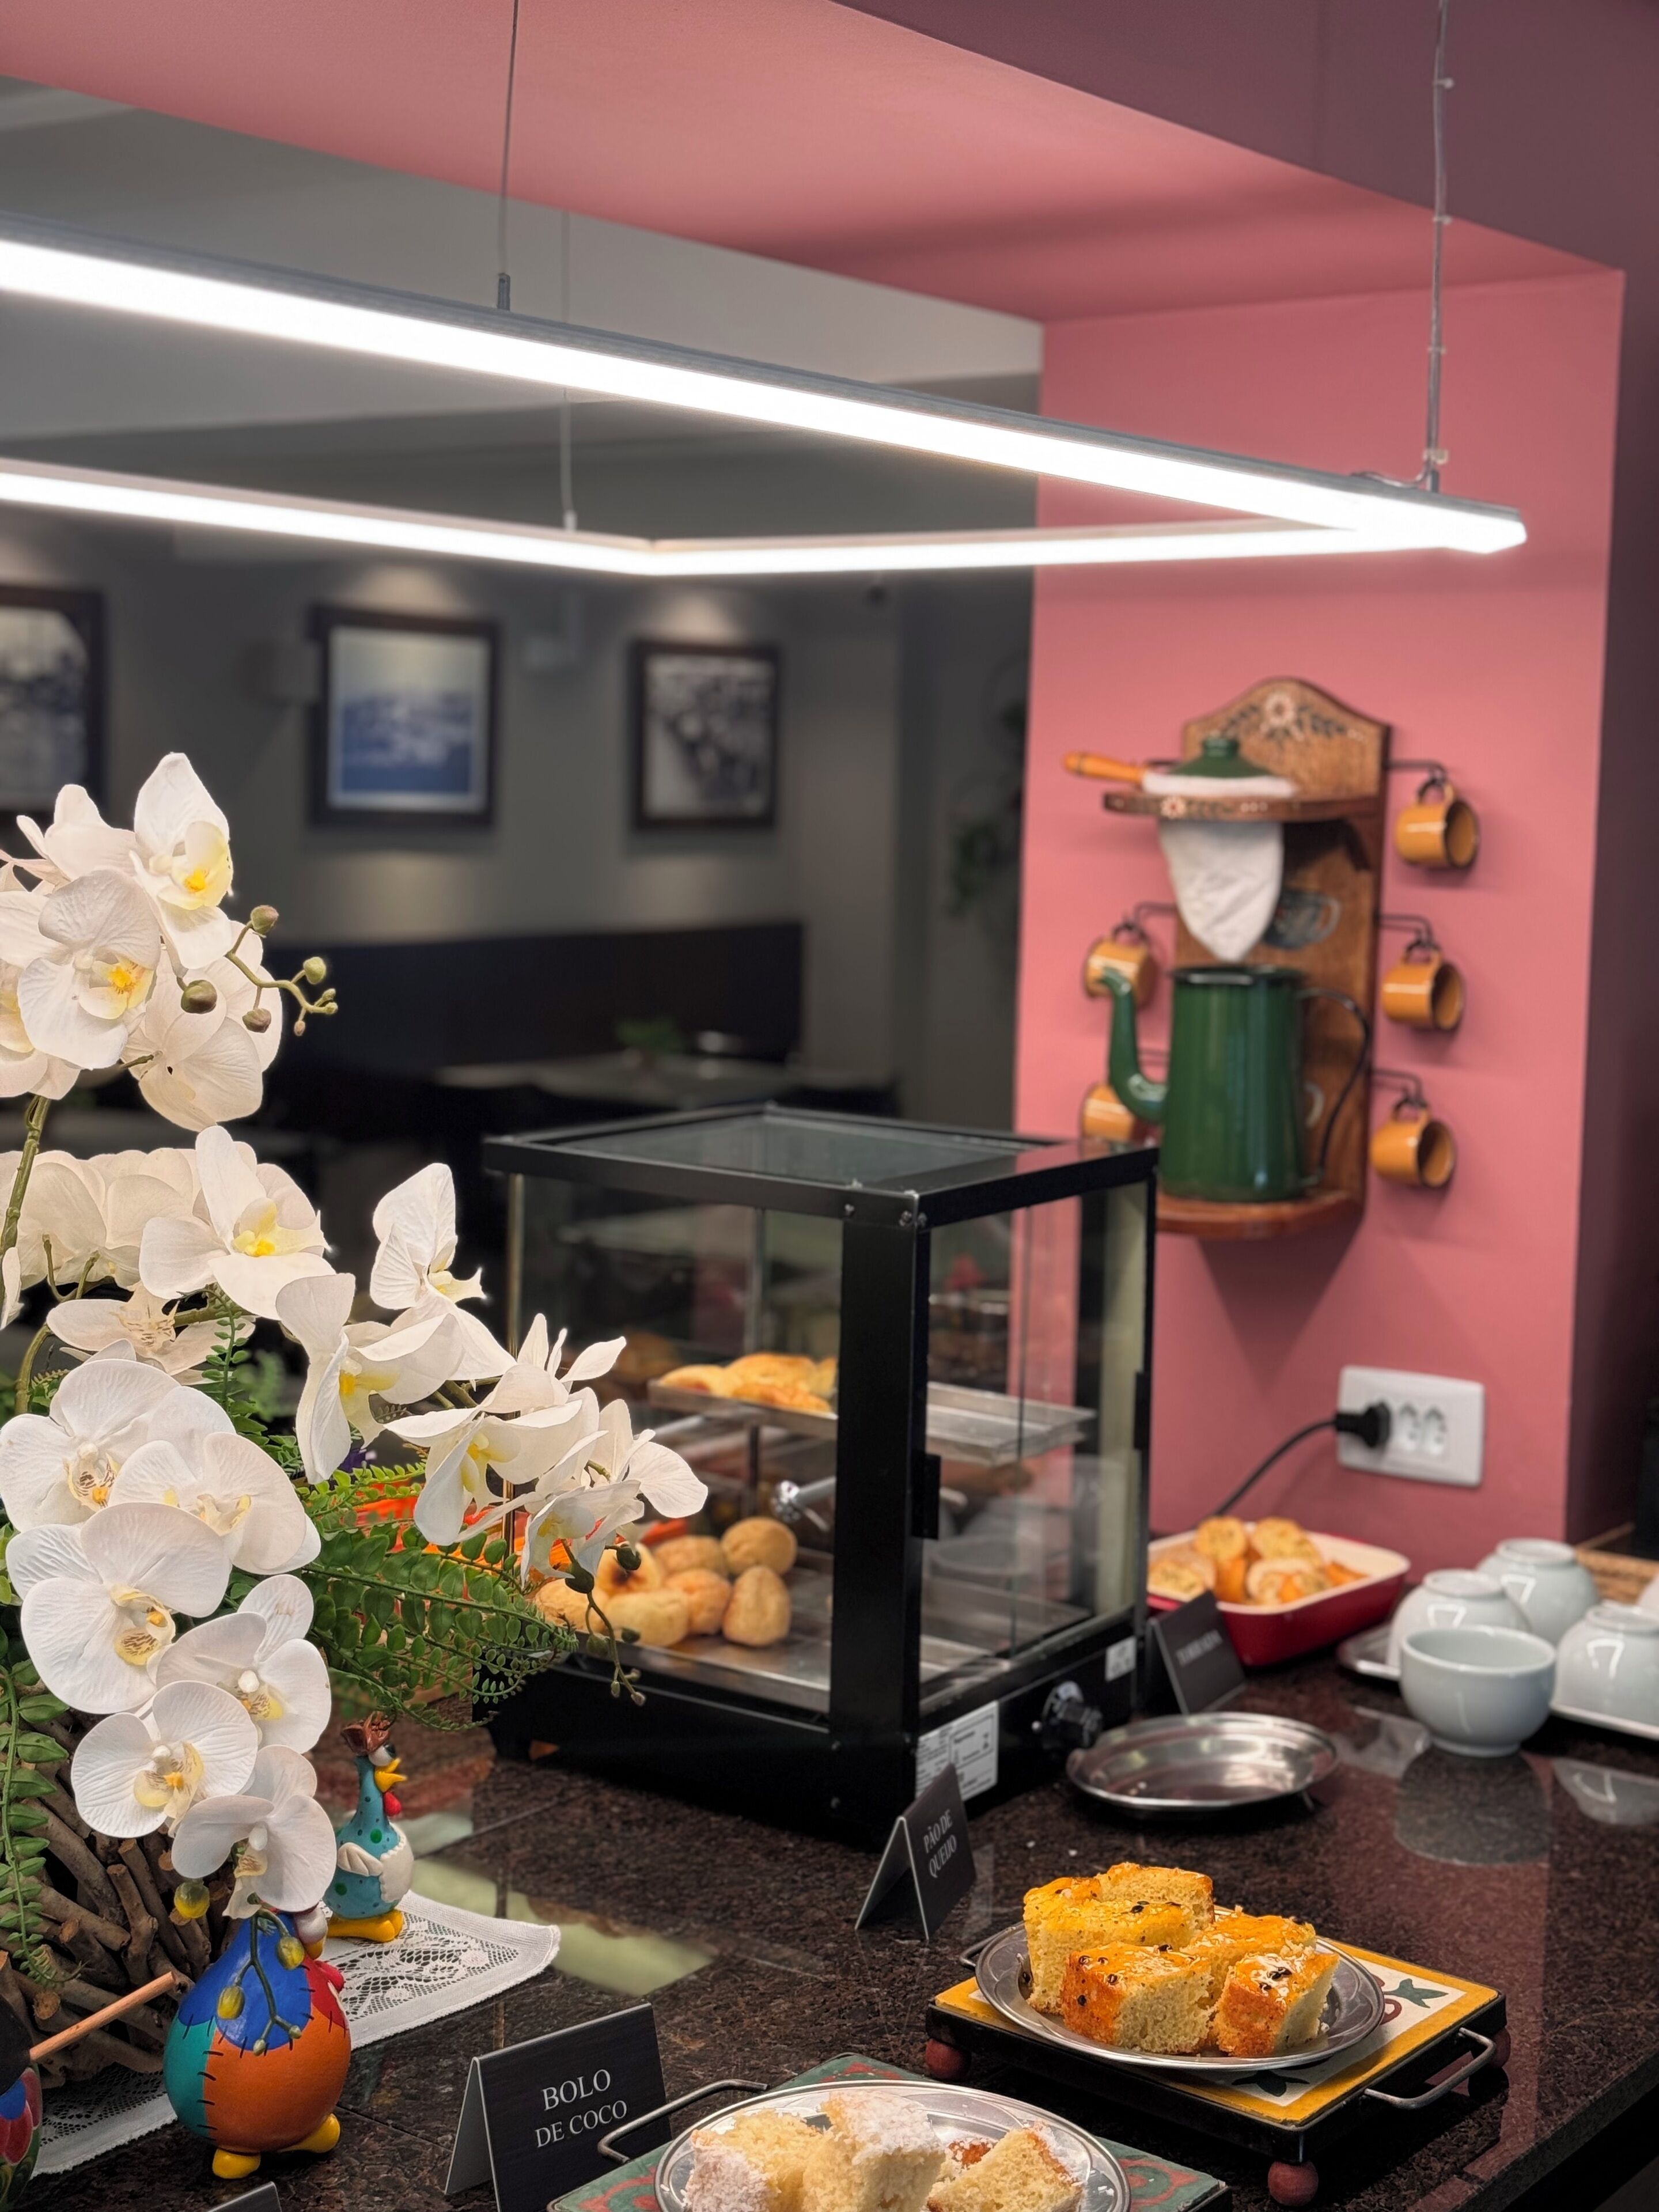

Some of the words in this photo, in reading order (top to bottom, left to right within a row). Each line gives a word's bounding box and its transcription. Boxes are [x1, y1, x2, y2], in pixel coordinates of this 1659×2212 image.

[940, 1809, 953, 1835] DE
[929, 1834, 957, 1878] QUEIJO
[542, 2069, 611, 2111] BOLO
[535, 2121, 565, 2148] DE
[570, 2100, 627, 2135] COCO
